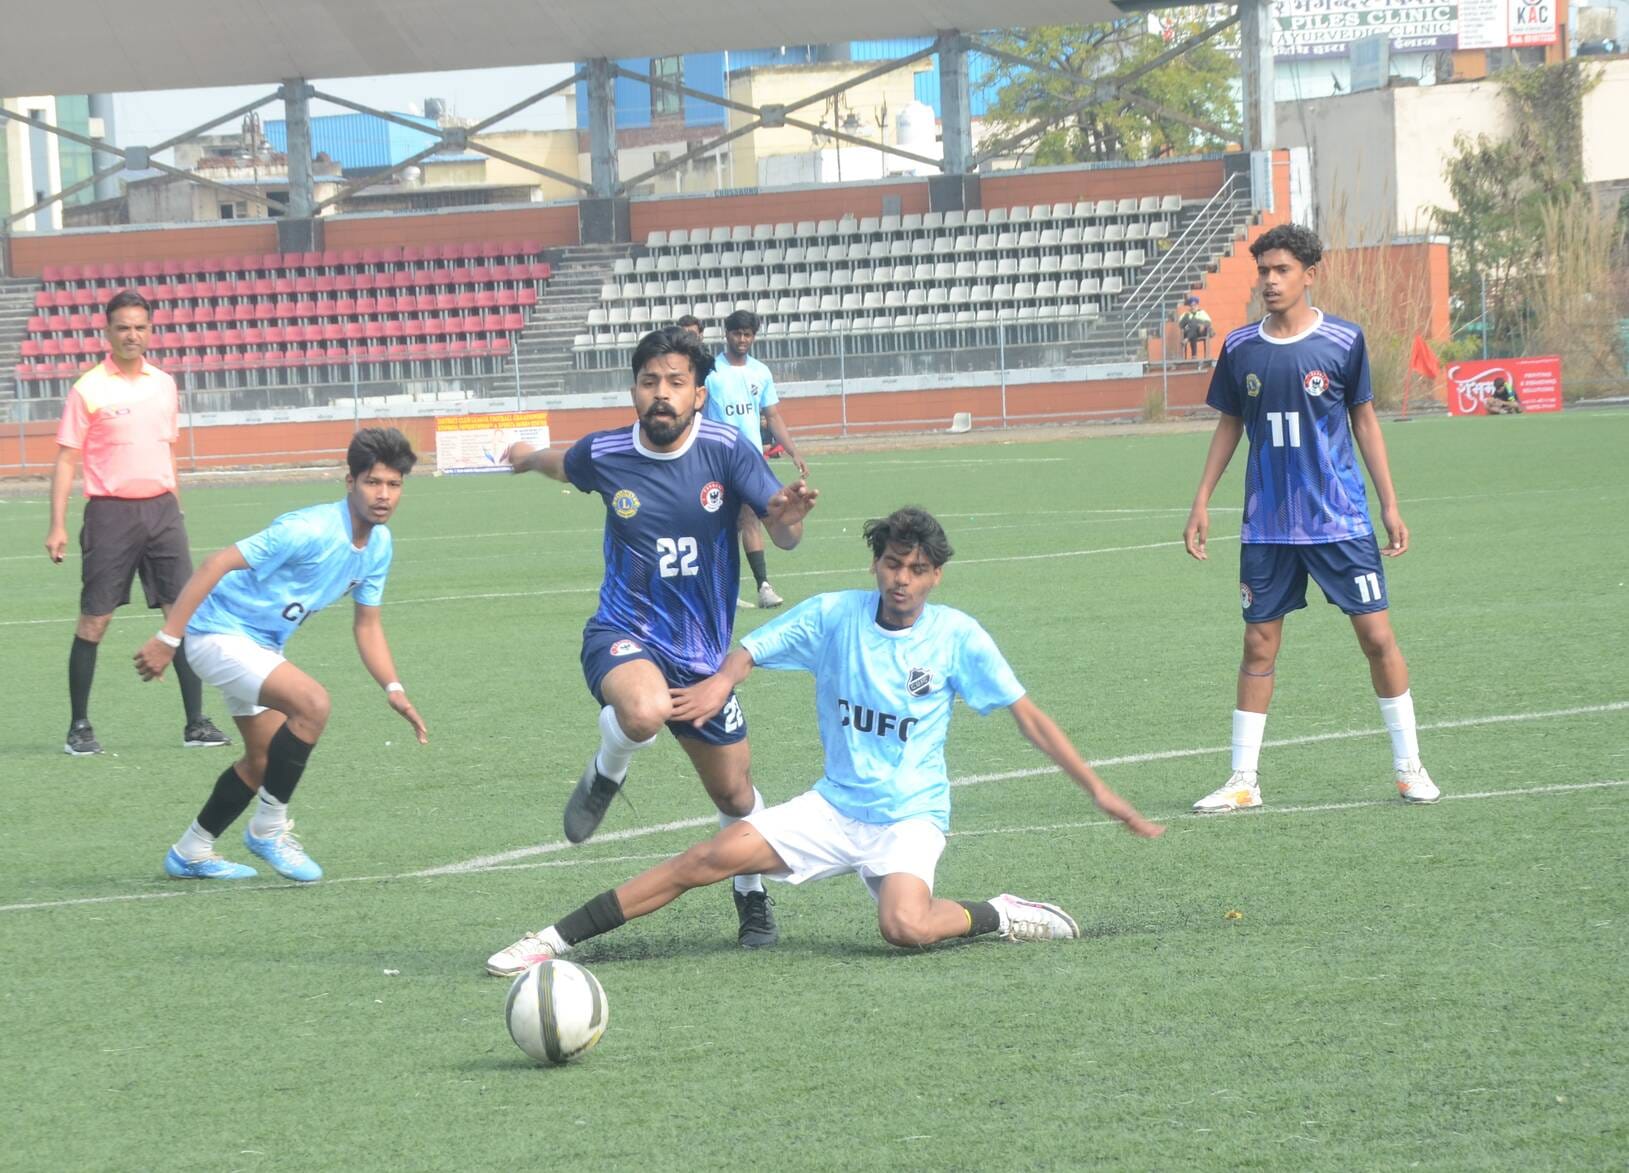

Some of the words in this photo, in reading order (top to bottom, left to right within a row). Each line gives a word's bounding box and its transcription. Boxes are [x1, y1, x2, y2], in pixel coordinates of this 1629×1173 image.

[1290, 12, 1361, 30] PILES
[1366, 6, 1451, 25] CLINIC
[1517, 6, 1548, 24] KAC
[1391, 23, 1450, 36] CLINIC
[1266, 411, 1300, 448] 11
[656, 536, 700, 578] 22
[1354, 572, 1381, 603] 11
